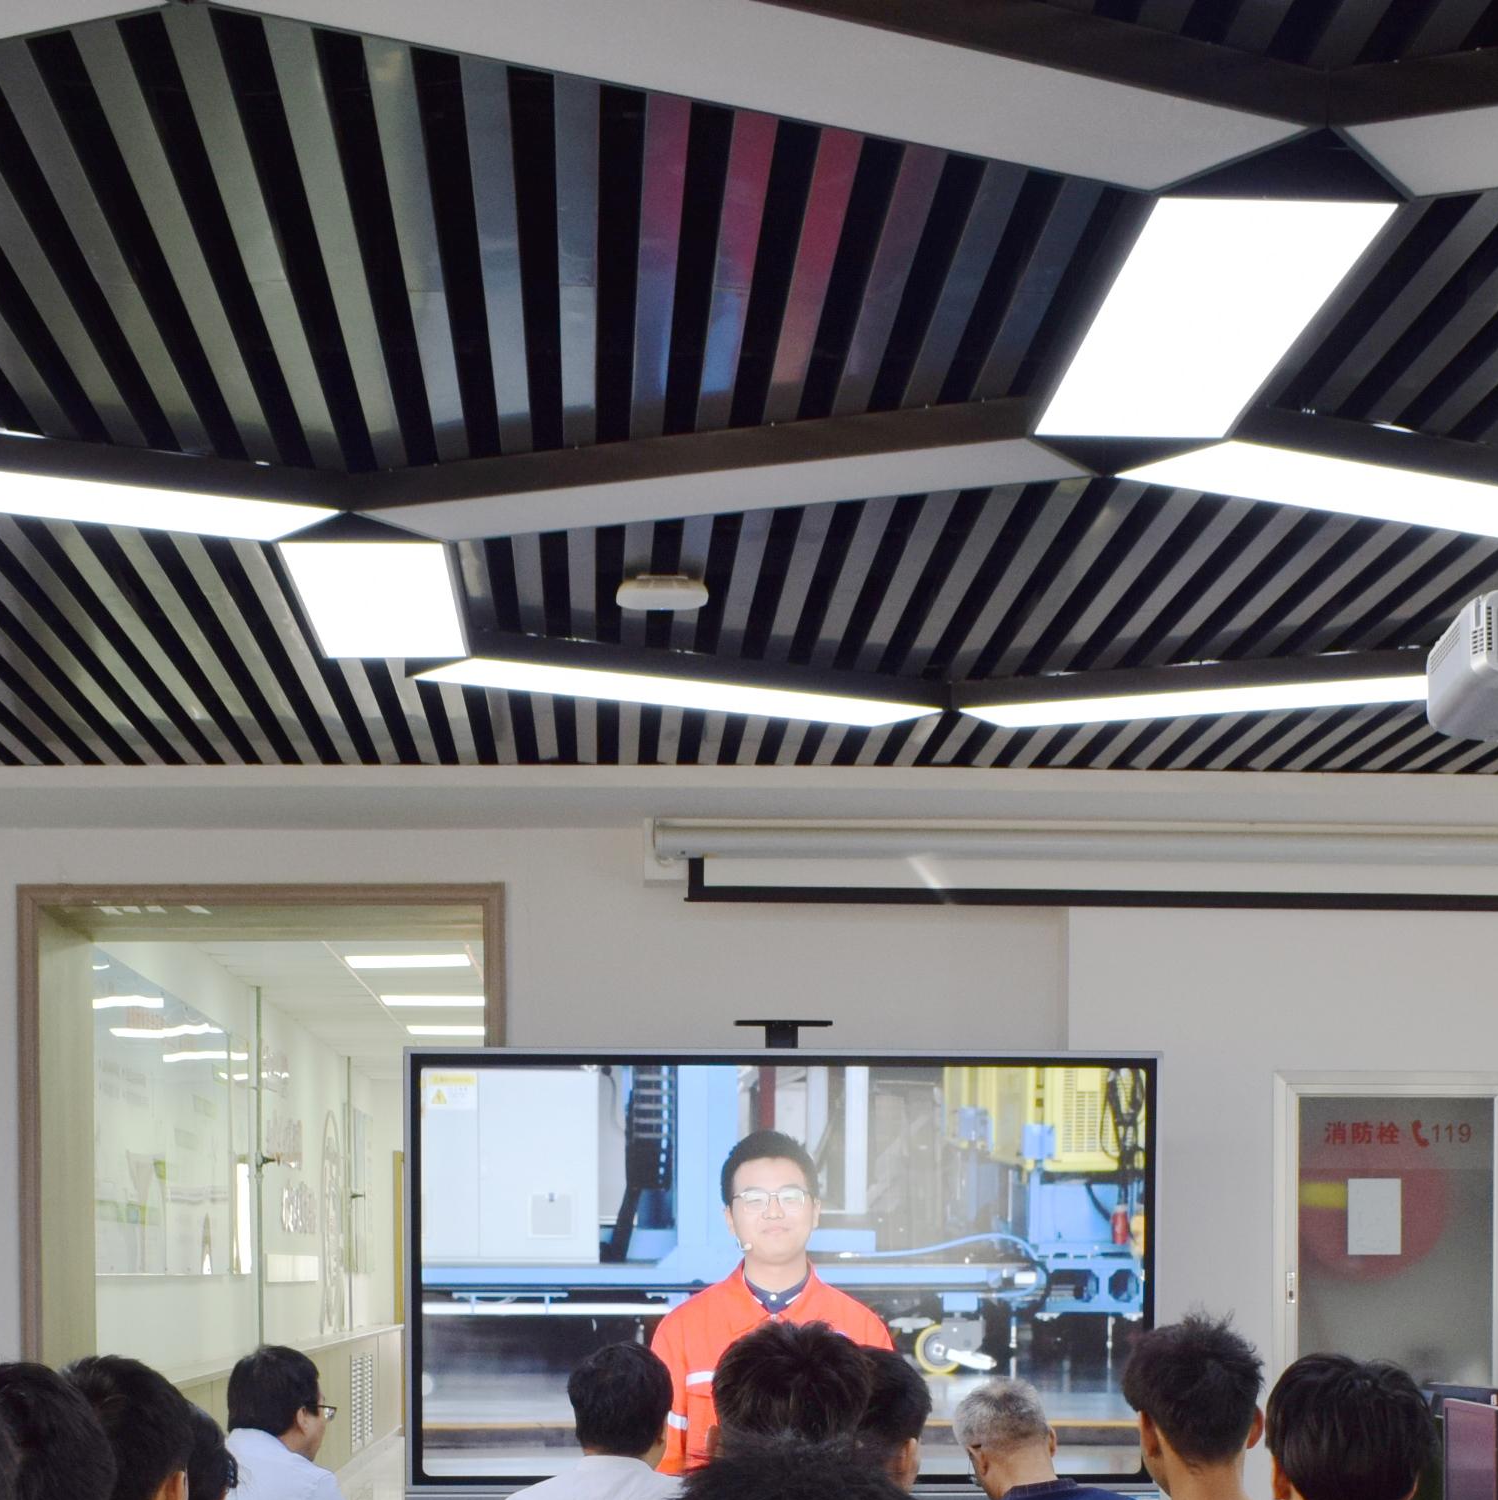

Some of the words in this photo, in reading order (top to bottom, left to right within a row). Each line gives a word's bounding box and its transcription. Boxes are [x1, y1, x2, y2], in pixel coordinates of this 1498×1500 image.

[1325, 1120, 1400, 1145] 消防栓
[1431, 1123, 1472, 1143] 119
